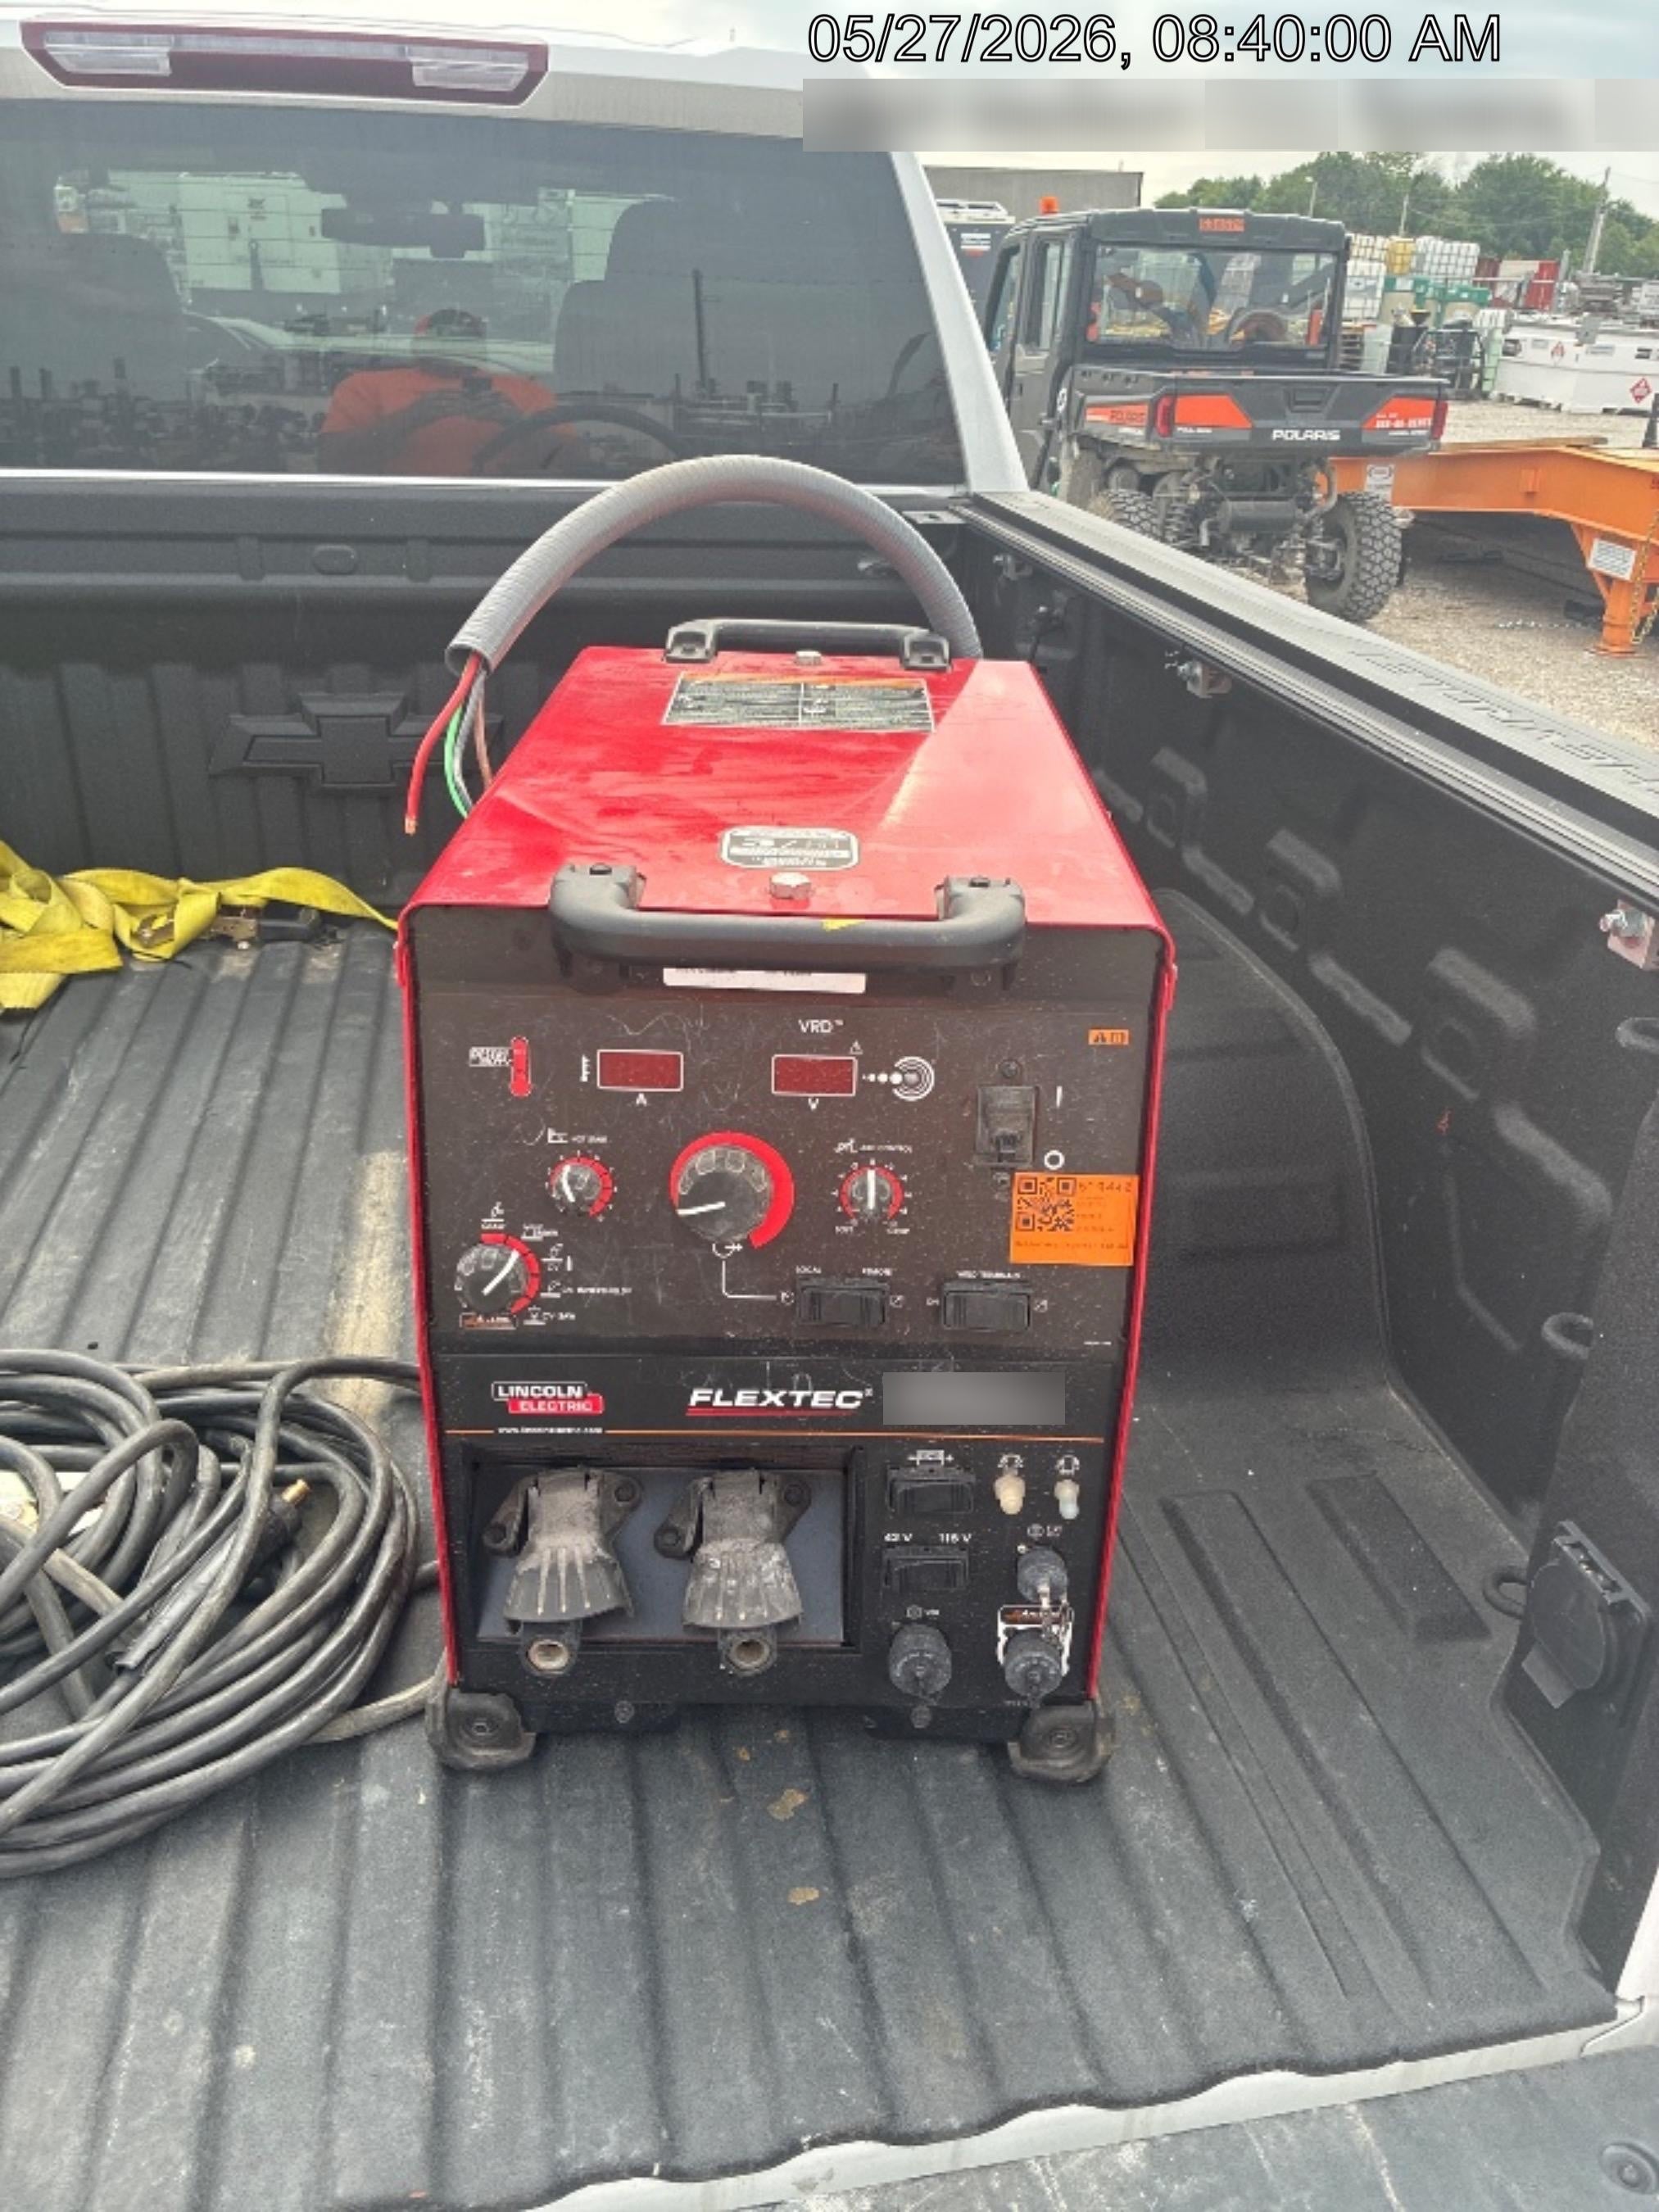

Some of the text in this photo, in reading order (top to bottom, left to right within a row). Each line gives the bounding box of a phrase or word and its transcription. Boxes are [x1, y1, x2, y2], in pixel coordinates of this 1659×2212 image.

[1271, 429, 1341, 442] POLARIS
[497, 1385, 583, 1398] LINCOLN
[519, 1400, 593, 1412] ELECTRIC
